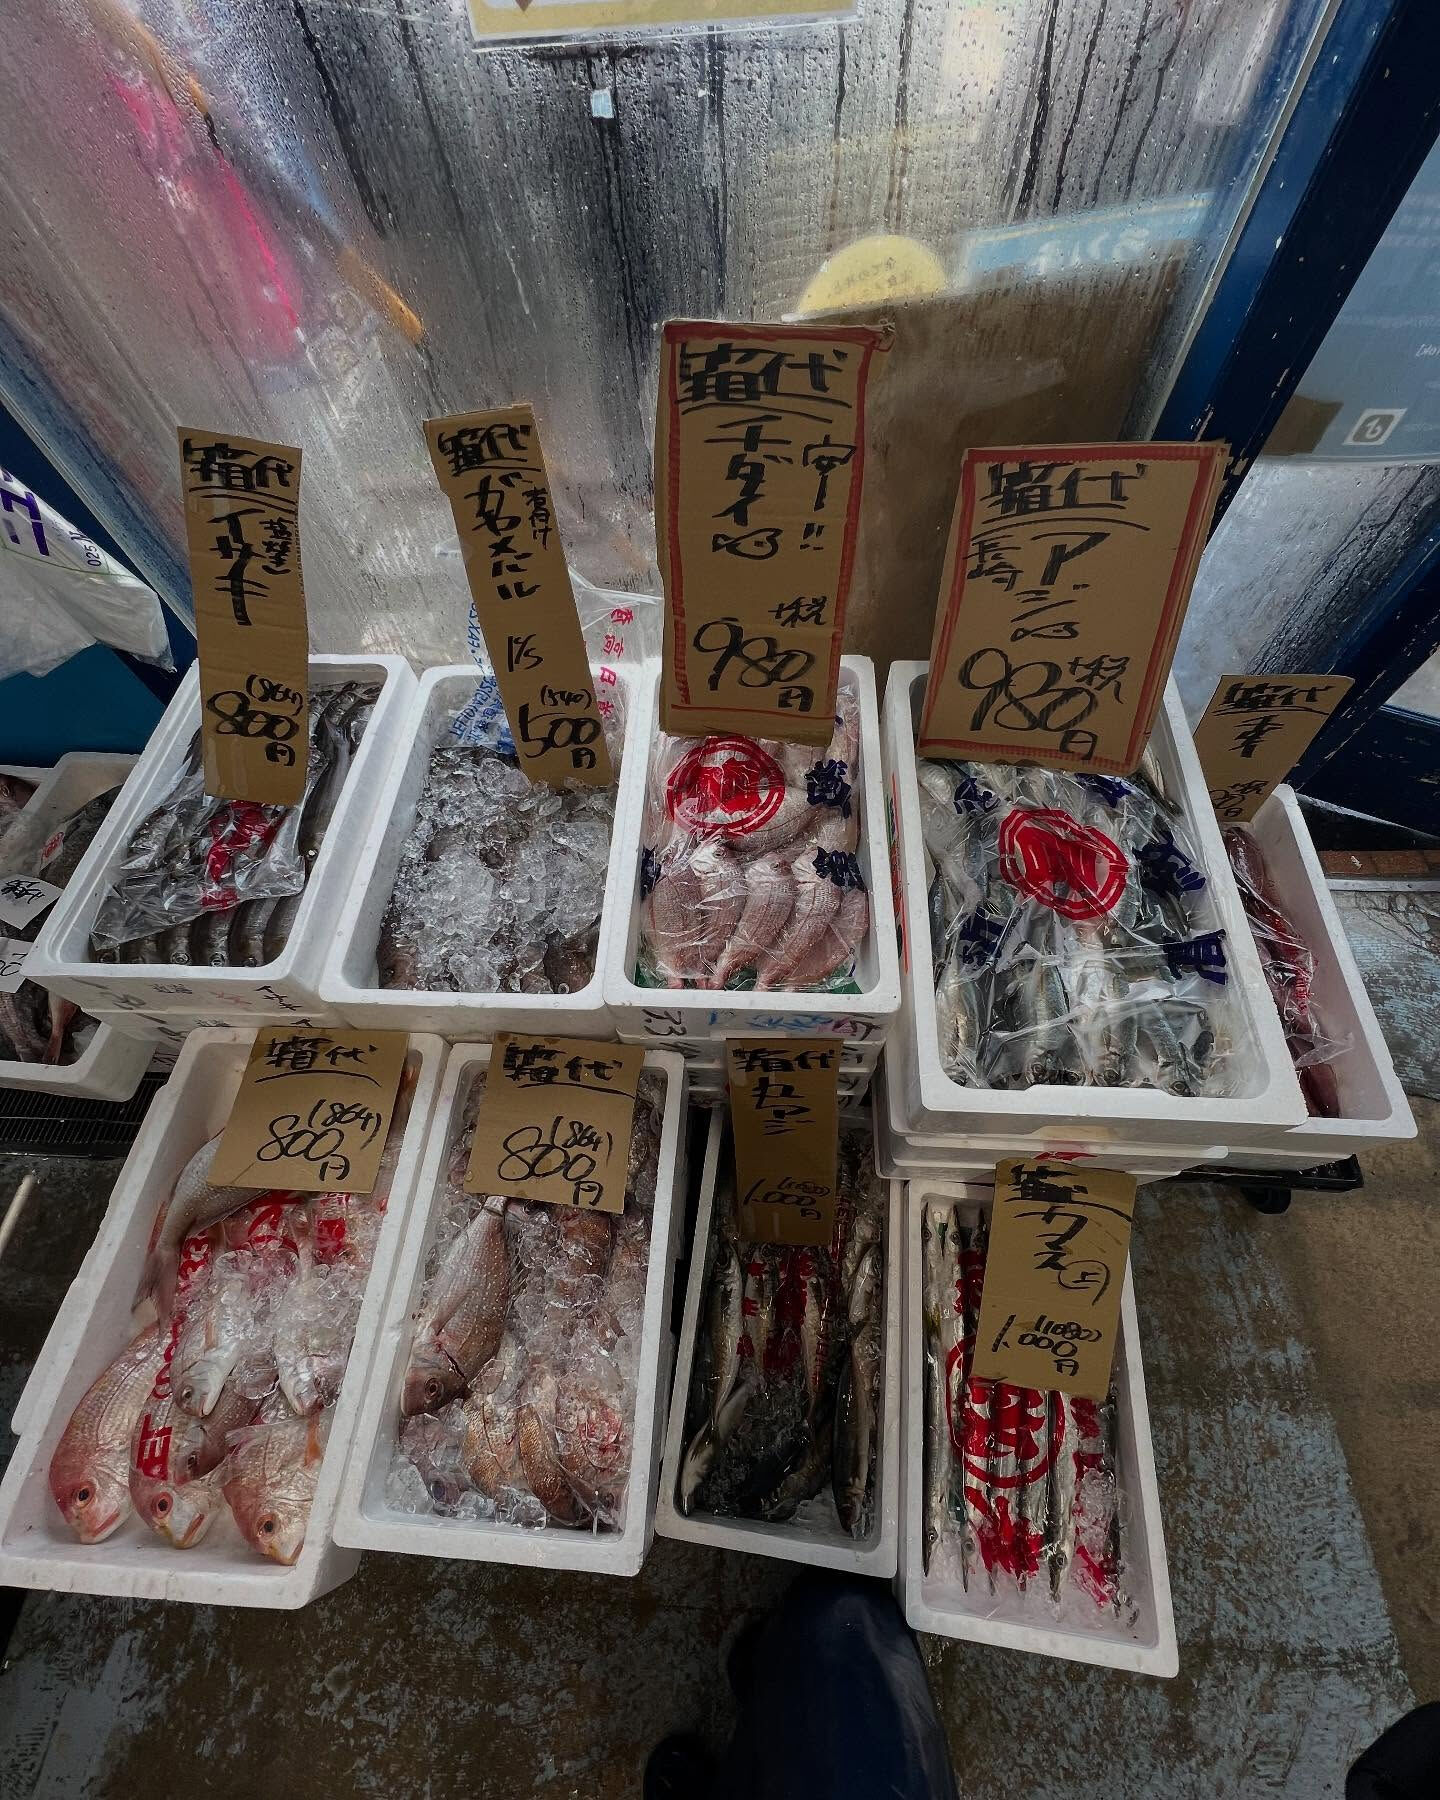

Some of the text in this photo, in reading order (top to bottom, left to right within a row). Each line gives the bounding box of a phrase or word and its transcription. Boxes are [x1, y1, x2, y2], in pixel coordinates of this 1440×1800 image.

[693, 617, 815, 691] 980
[958, 647, 1098, 731] 980
[257, 1114, 345, 1162] 800
[308, 1099, 381, 1150] (864)
[498, 1127, 597, 1181] 800
